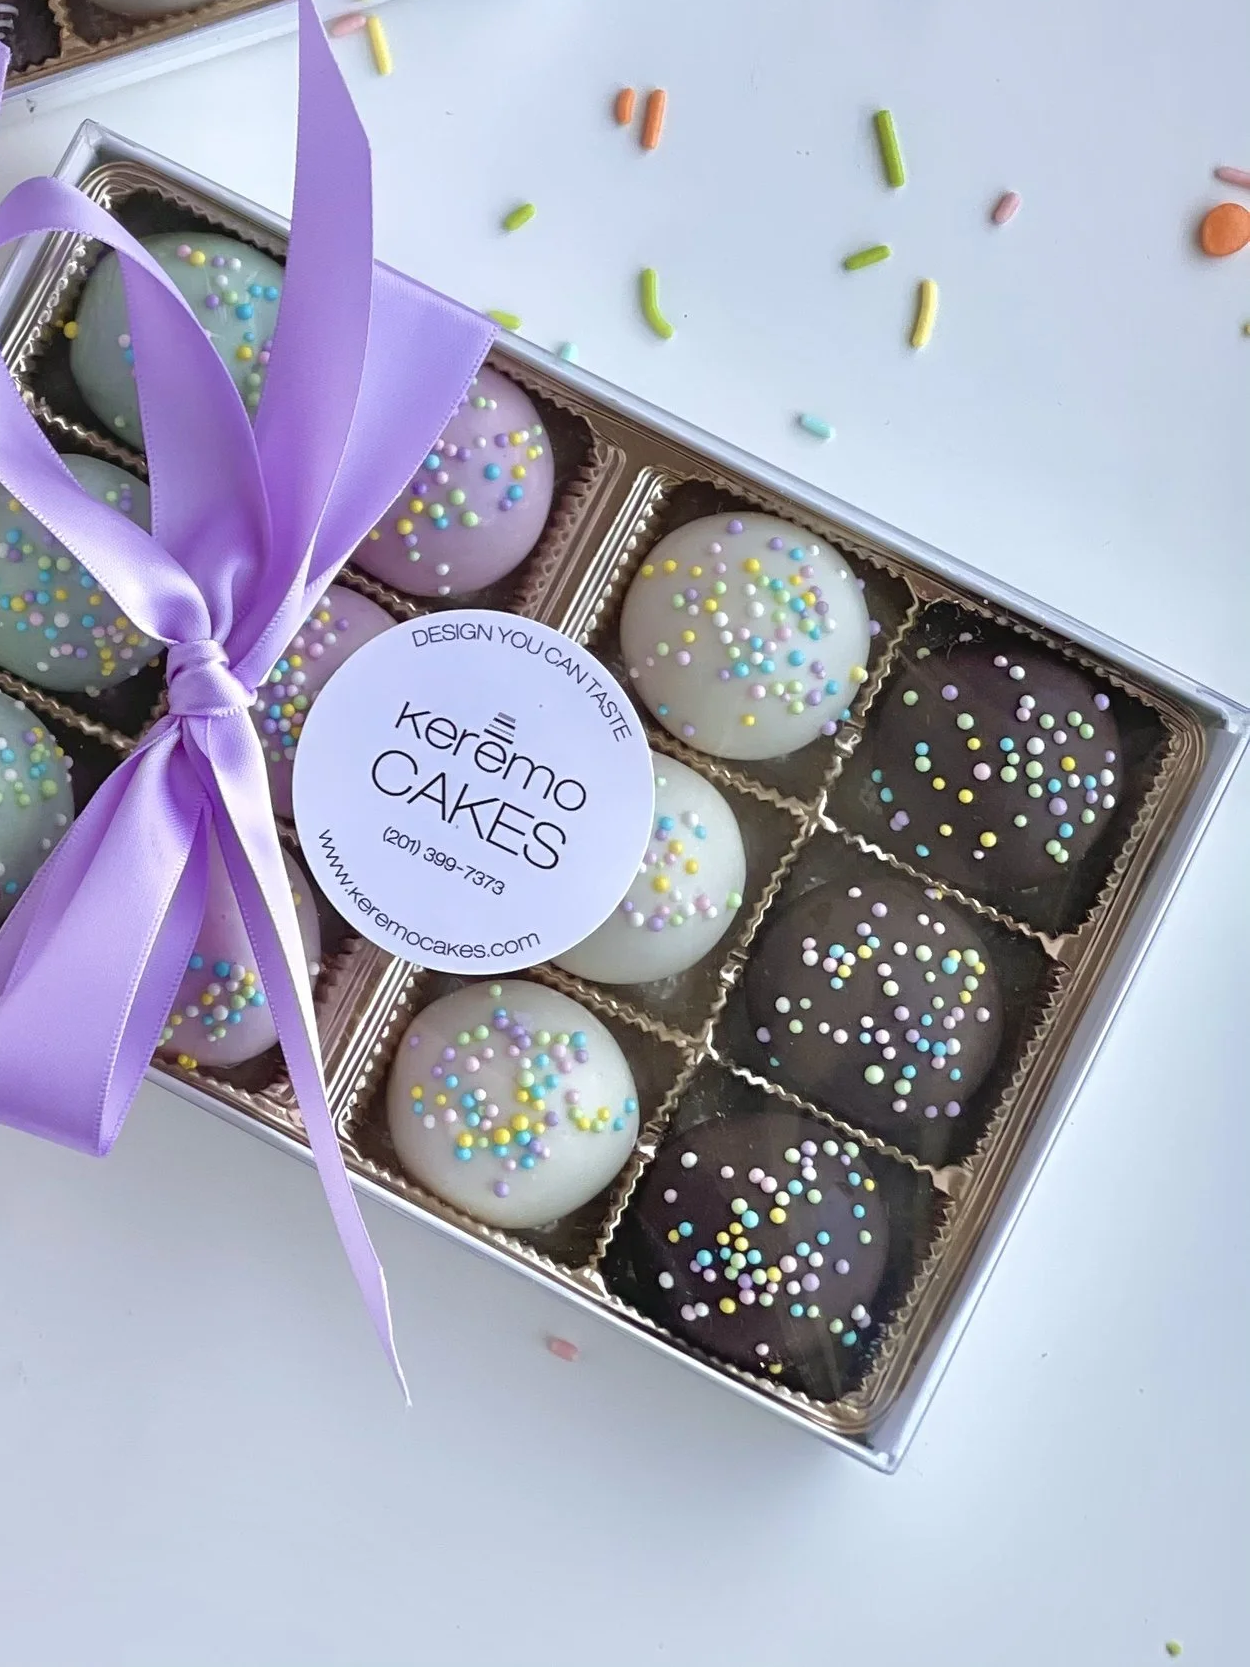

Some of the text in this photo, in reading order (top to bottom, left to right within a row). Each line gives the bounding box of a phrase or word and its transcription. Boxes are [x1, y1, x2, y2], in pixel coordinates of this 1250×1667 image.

[411, 622, 632, 743] DESIGN YOU CAN TASTE
[371, 749, 567, 870] CAKES
[382, 826, 506, 896] (201) 399-7373
[318, 829, 541, 959] www.keremocakes.com
